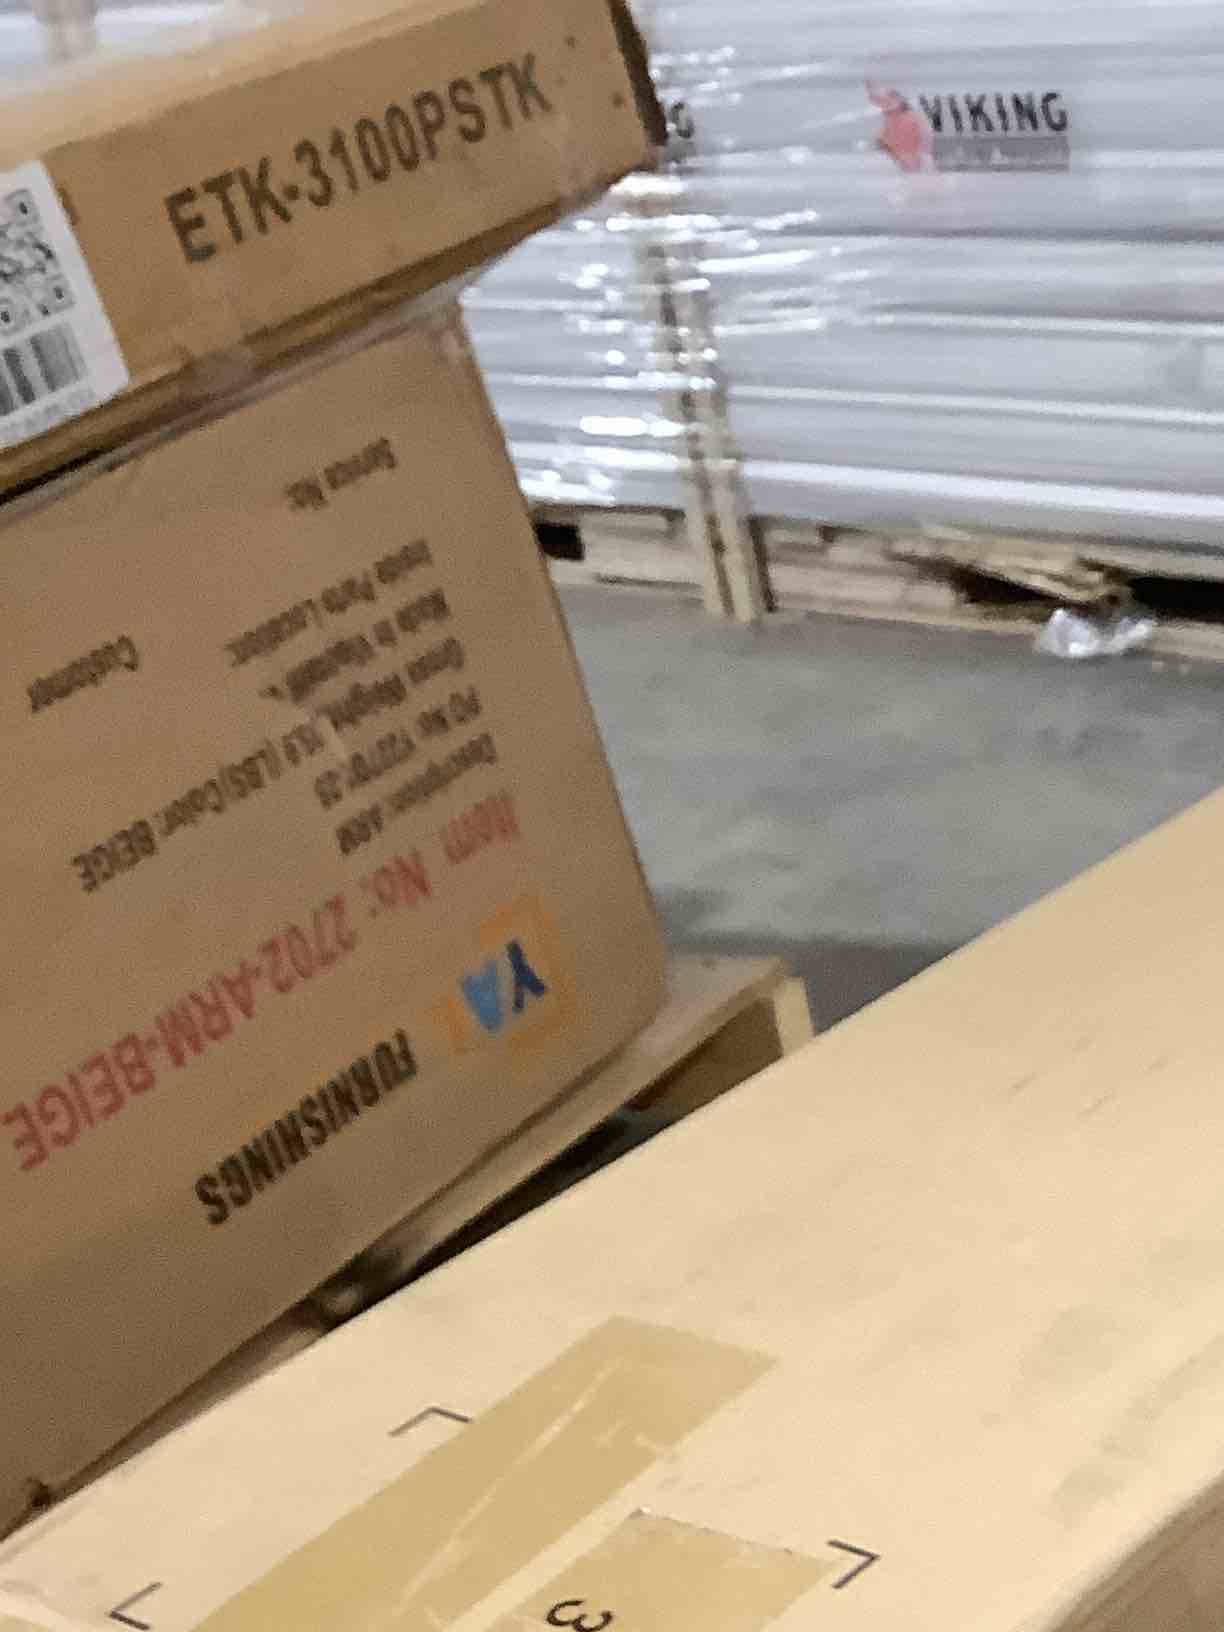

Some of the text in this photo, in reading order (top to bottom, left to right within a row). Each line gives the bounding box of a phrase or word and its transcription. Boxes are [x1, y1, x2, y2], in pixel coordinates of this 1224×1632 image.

[163, 52, 555, 263] ETK-3100PSTK
[919, 92, 1068, 133] VIKING
[71, 818, 157, 892] BEIGE
[1, 895, 356, 1171] 2702-ARM-BEIGE
[194, 1027, 416, 1225] FURNISHINGS
